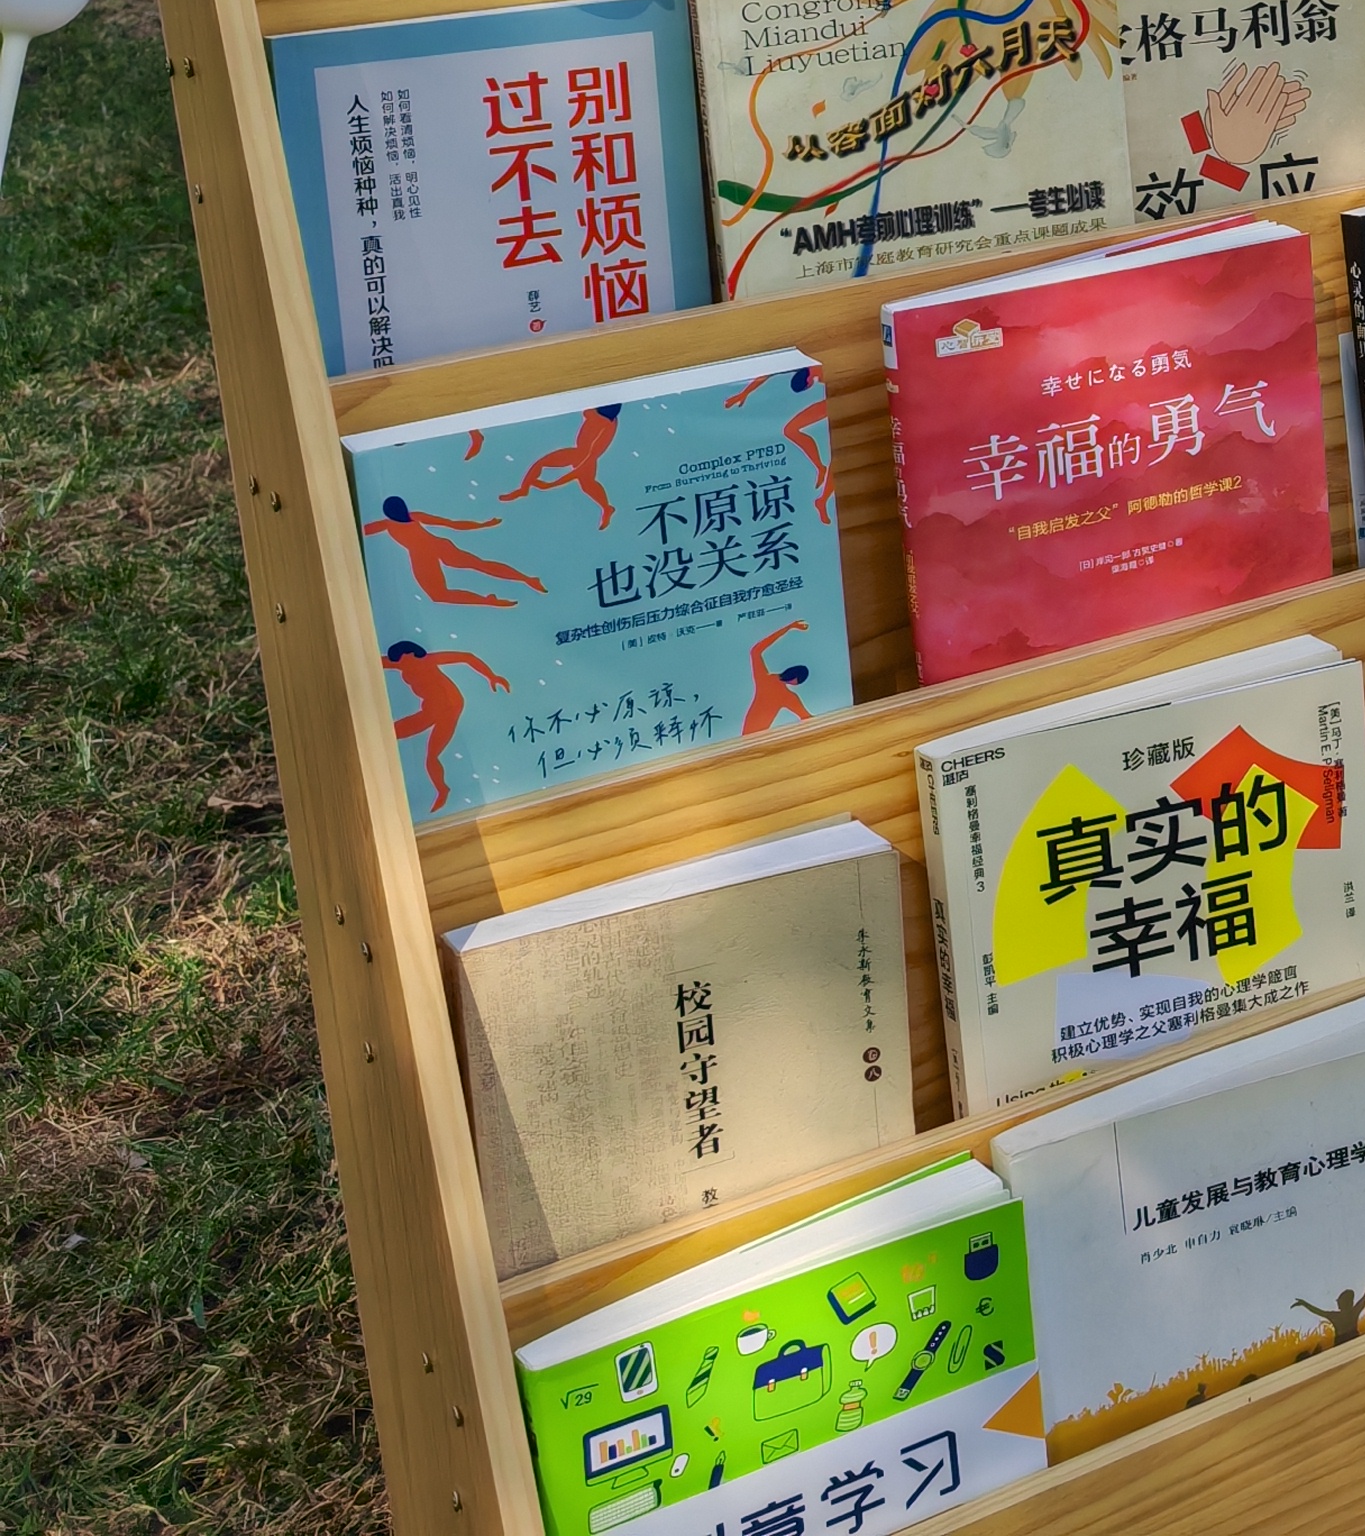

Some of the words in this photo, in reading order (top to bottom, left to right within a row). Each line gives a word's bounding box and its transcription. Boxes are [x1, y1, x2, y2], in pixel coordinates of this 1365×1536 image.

[743, 15, 868, 52] Miandui
[745, 39, 906, 78] Liuyuetian
[782, 14, 1081, 162] 从容面对六月天
[481, 71, 563, 270] 过不去
[567, 61, 650, 324] 别和烦恼
[796, 216, 1108, 279] 上海市家庭教育研究会重点课题成果
[1041, 350, 1192, 397] 幸せになる勇気
[675, 469, 729, 488] Surviving
[730, 466, 740, 475] to
[741, 456, 787, 473] Thriving
[679, 454, 741, 475] Complex
[746, 443, 786, 461] PTSD
[963, 380, 1277, 502] 幸福的勇气
[635, 474, 797, 545] 不原谅
[1127, 475, 1242, 517] 阿德勒的哲学课2
[587, 521, 801, 608] 也没关系
[555, 575, 805, 646] 复杂性创伤后压力综合征自我疗愈圣经
[537, 705, 723, 779] 但必须释怀
[1122, 736, 1195, 772] 珍藏版
[1317, 705, 1329, 743] Martin
[941, 747, 1006, 773] CHEERS
[1322, 768, 1335, 824] Seligman
[1035, 773, 1288, 905] 真实的
[1089, 869, 1258, 978] 幸福
[1051, 980, 1310, 1064] 积极心理学之父塞利格曼集大成之作
[675, 980, 724, 1160] 校园守望者
[714, 1429, 961, 1536] 意学习
